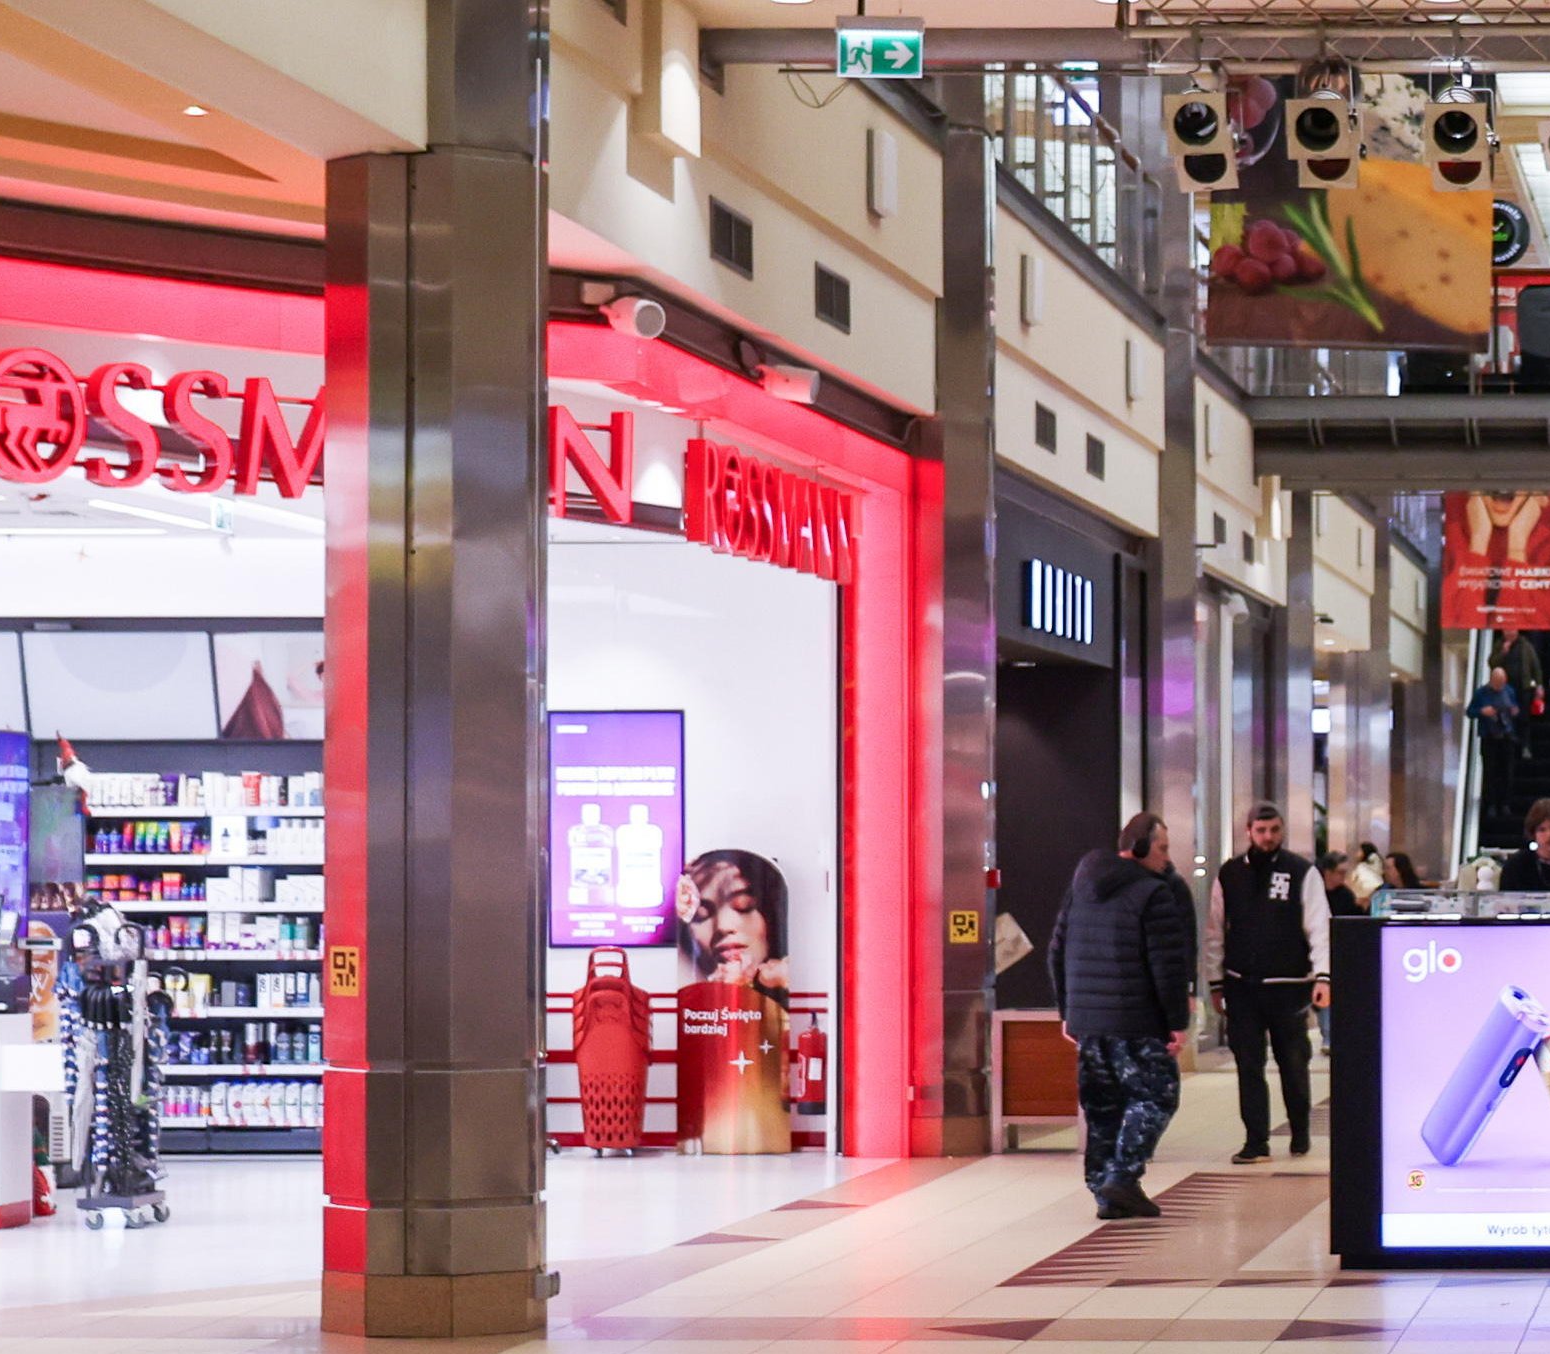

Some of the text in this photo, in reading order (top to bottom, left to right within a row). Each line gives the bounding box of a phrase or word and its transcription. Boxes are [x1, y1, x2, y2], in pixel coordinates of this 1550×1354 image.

[687, 438, 853, 585] ROSSMANN
[1402, 940, 1462, 983] glo
[684, 1006, 762, 1023] Poczuj Święta
[684, 1023, 728, 1037] bardziej
